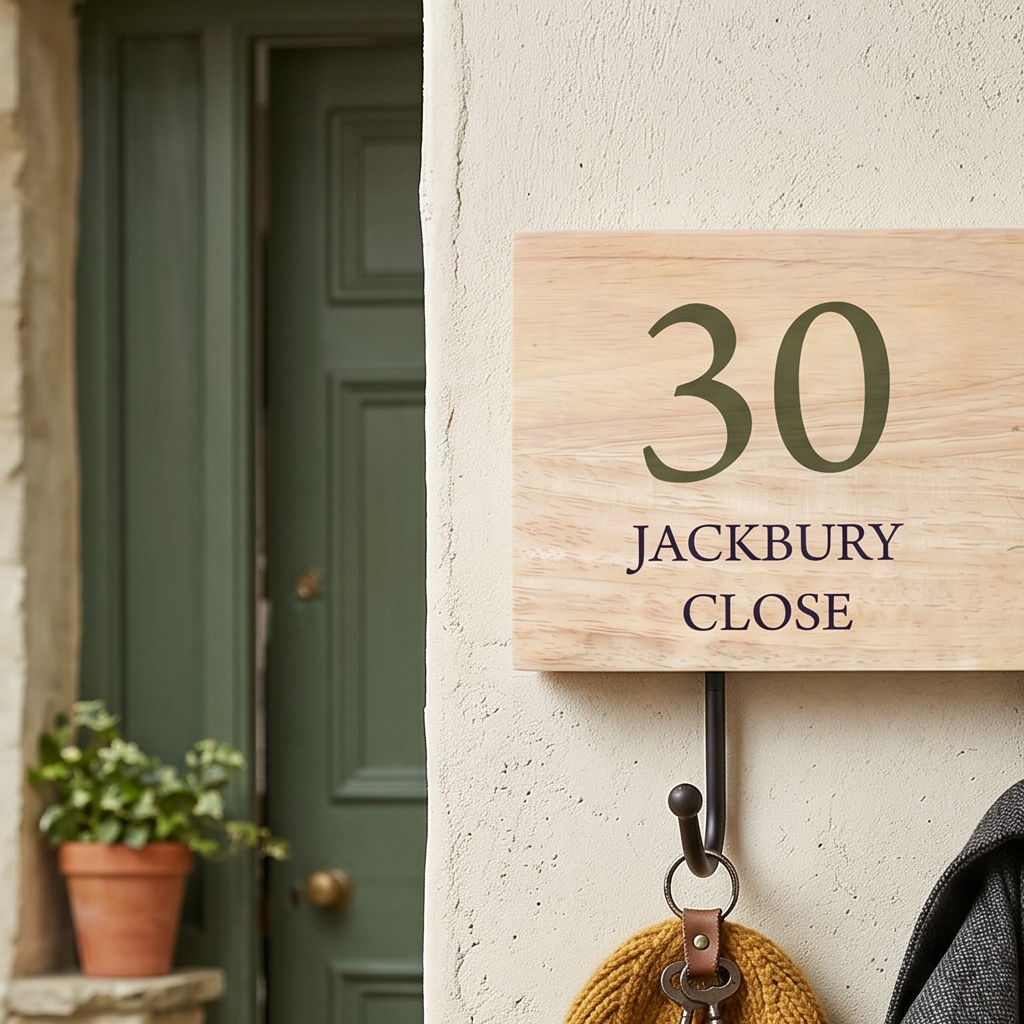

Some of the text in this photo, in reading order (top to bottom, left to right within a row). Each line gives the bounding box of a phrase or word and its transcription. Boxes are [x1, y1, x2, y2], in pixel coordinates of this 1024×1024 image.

[642, 301, 891, 484] 30
[626, 523, 905, 576] JACKBURY
[682, 593, 854, 632] CLOSE
